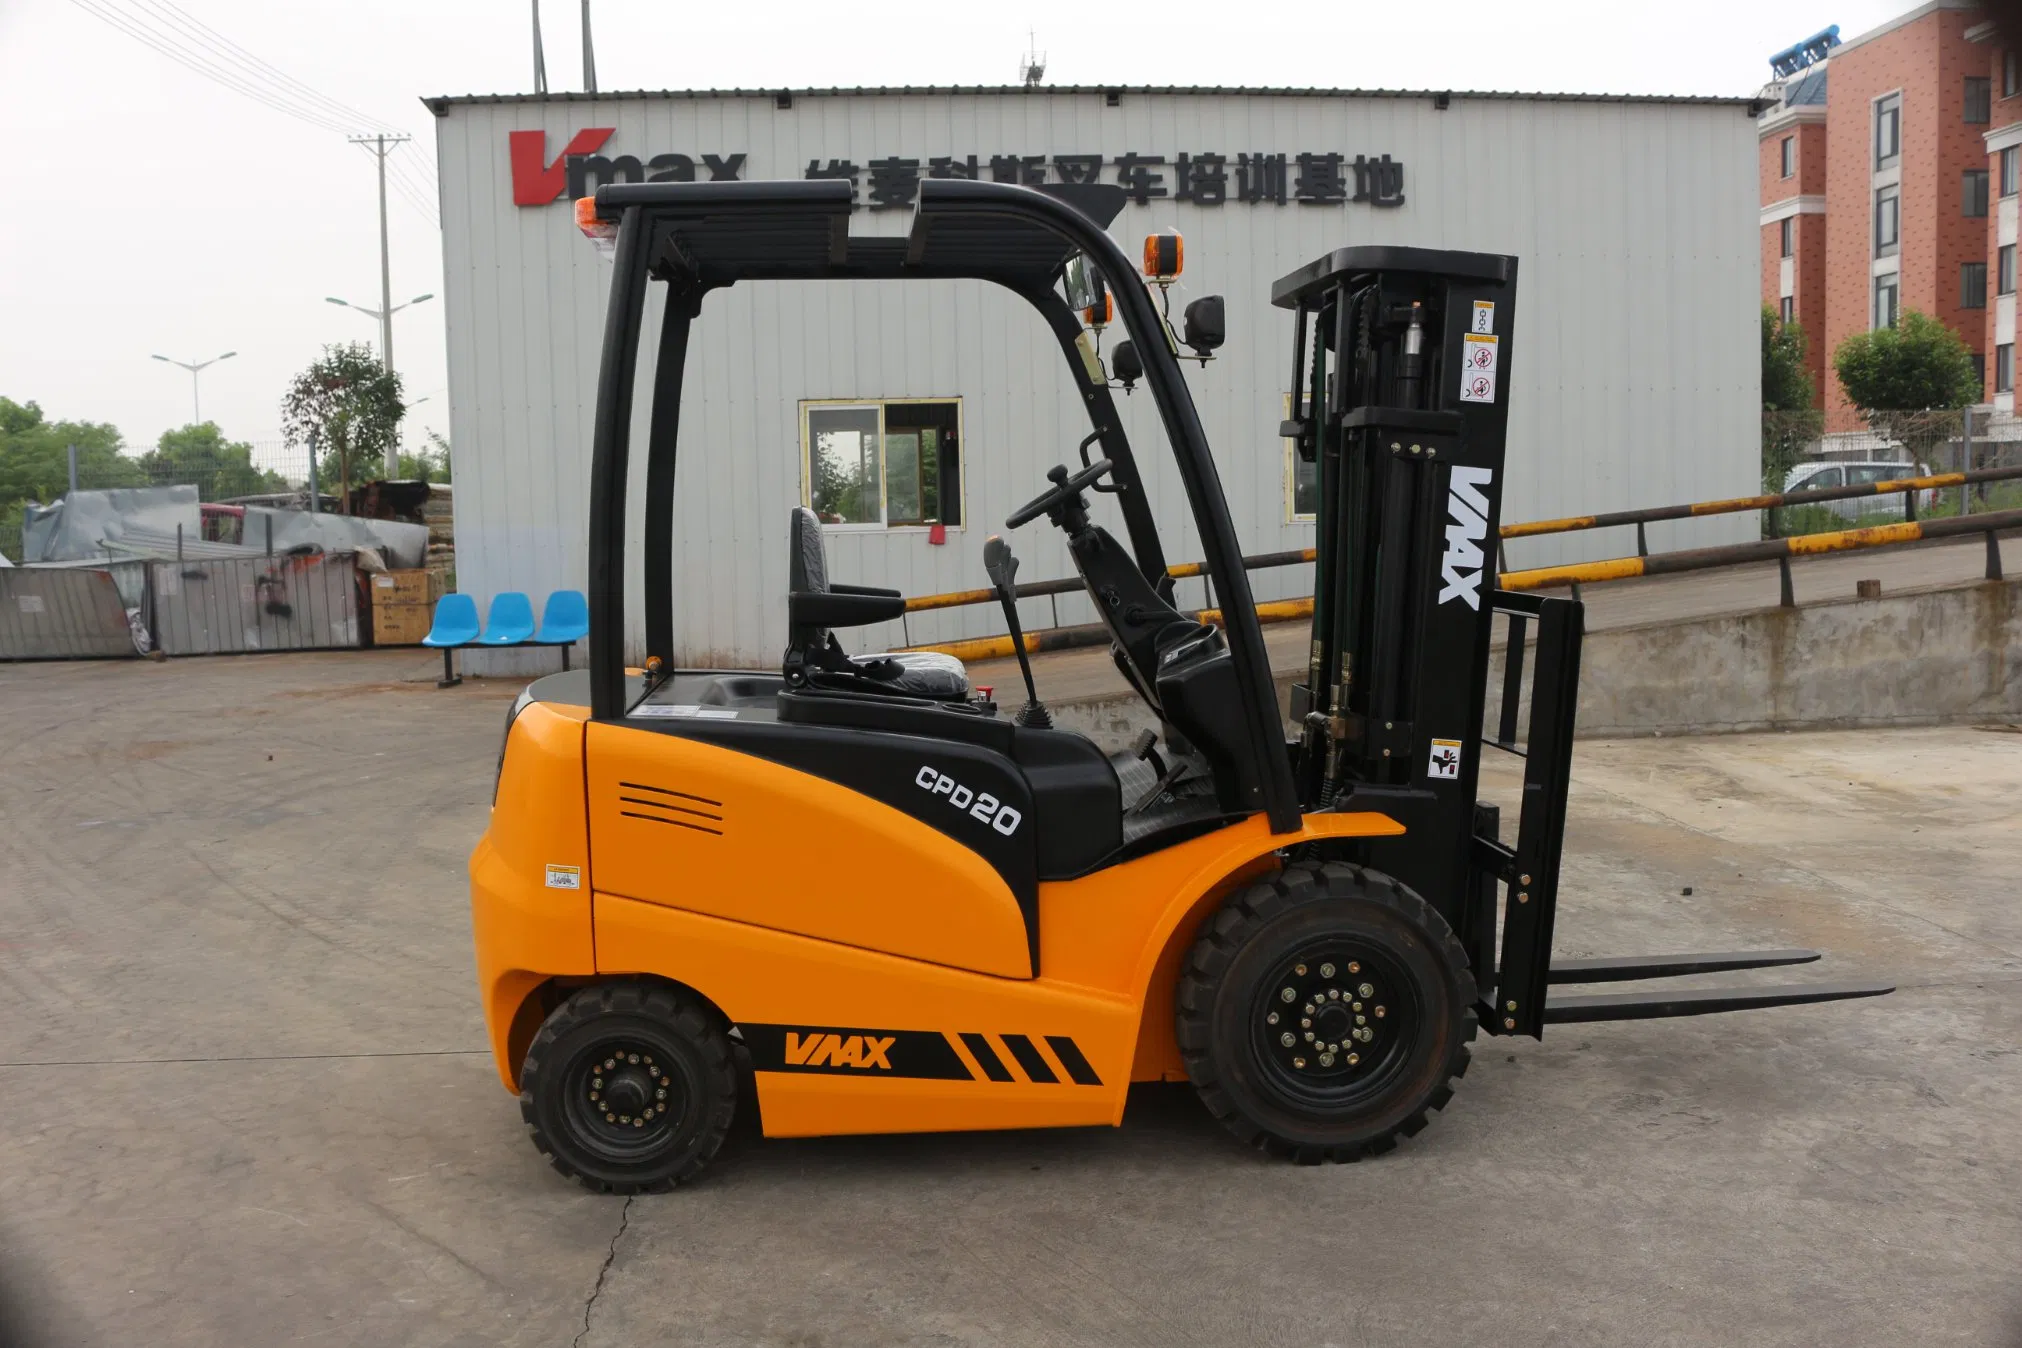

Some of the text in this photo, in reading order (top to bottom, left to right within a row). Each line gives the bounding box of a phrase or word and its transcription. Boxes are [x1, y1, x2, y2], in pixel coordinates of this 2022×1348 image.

[509, 128, 747, 206] Vmax
[1438, 465, 1493, 611] VMAX
[915, 765, 1022, 836] CPD20
[785, 1032, 896, 1070] VMAX
